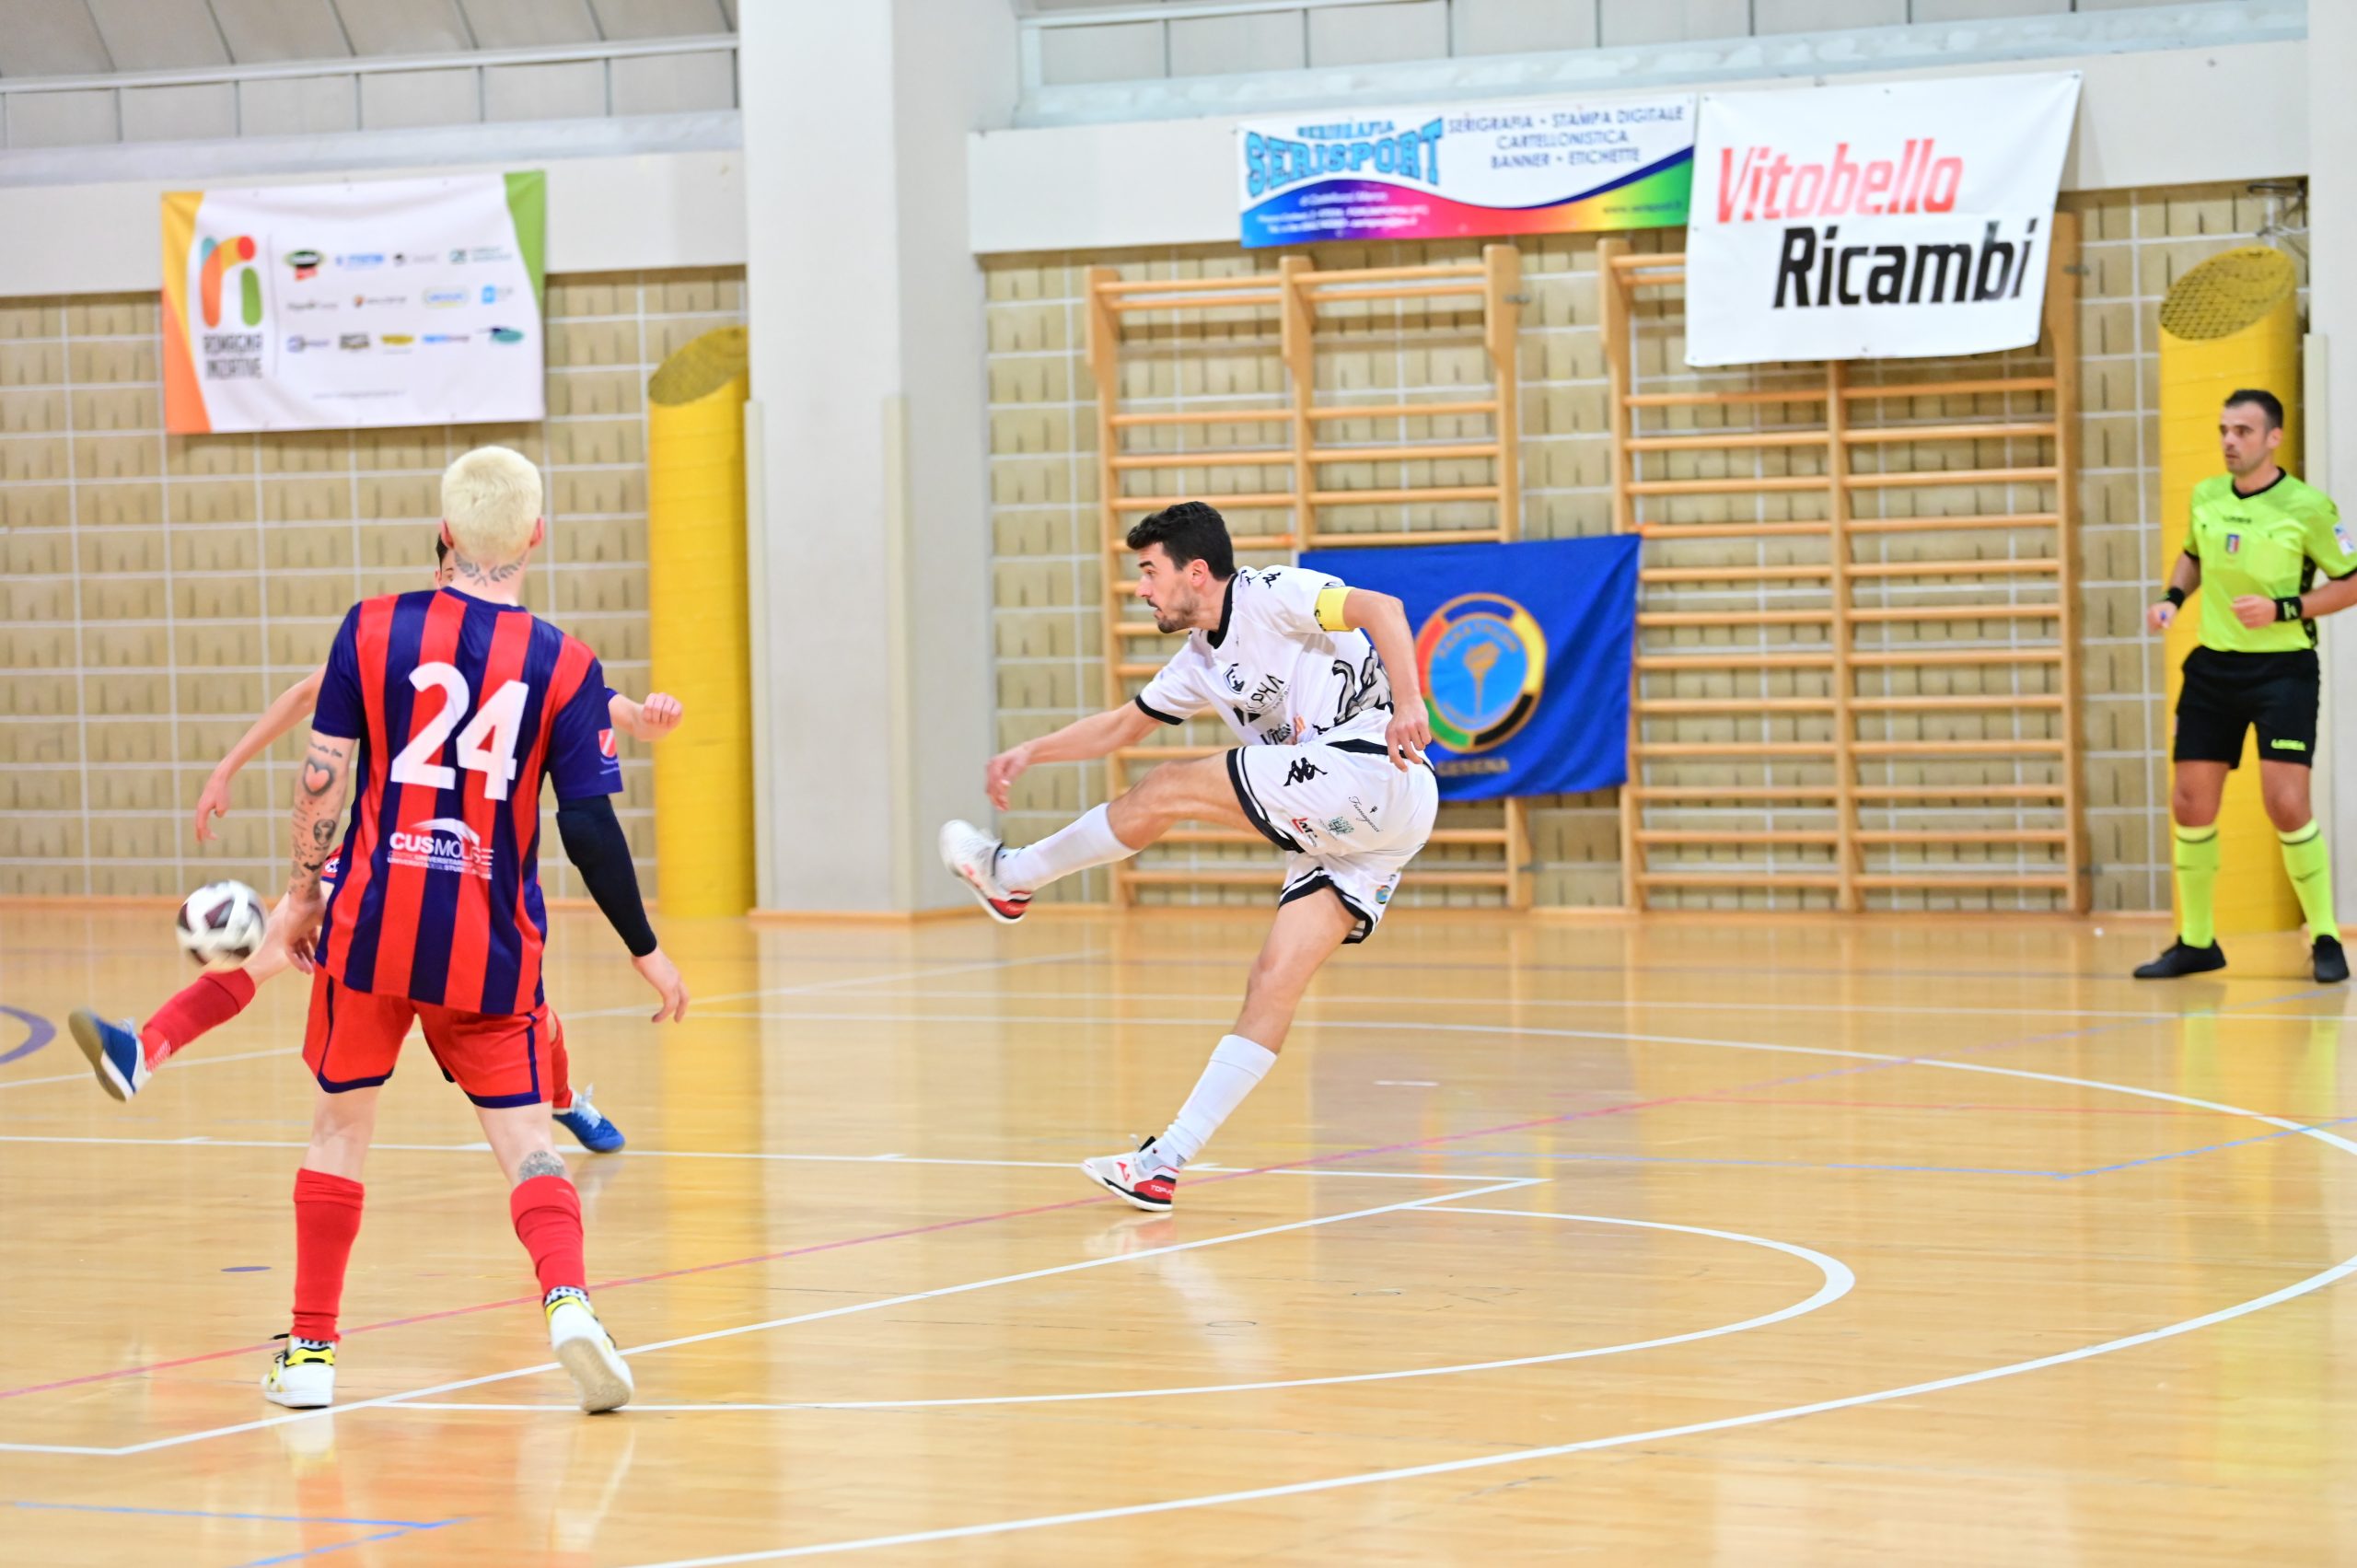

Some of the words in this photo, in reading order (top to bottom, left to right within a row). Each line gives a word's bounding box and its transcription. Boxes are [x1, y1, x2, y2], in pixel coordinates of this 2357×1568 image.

[1246, 117, 1443, 199] SERISPORT
[1448, 113, 1534, 134] SERIGRAFIA
[1552, 110, 1610, 128] STAMPA
[1617, 106, 1685, 123] DIGITALE
[1491, 153, 1550, 169] BANNER
[1568, 147, 1641, 167] ETICHETTE
[1496, 130, 1629, 149] CARTELLONISTICA
[1716, 137, 1964, 224] Vitobello
[1771, 216, 2039, 309] Ricambi
[389, 661, 529, 802] 24
